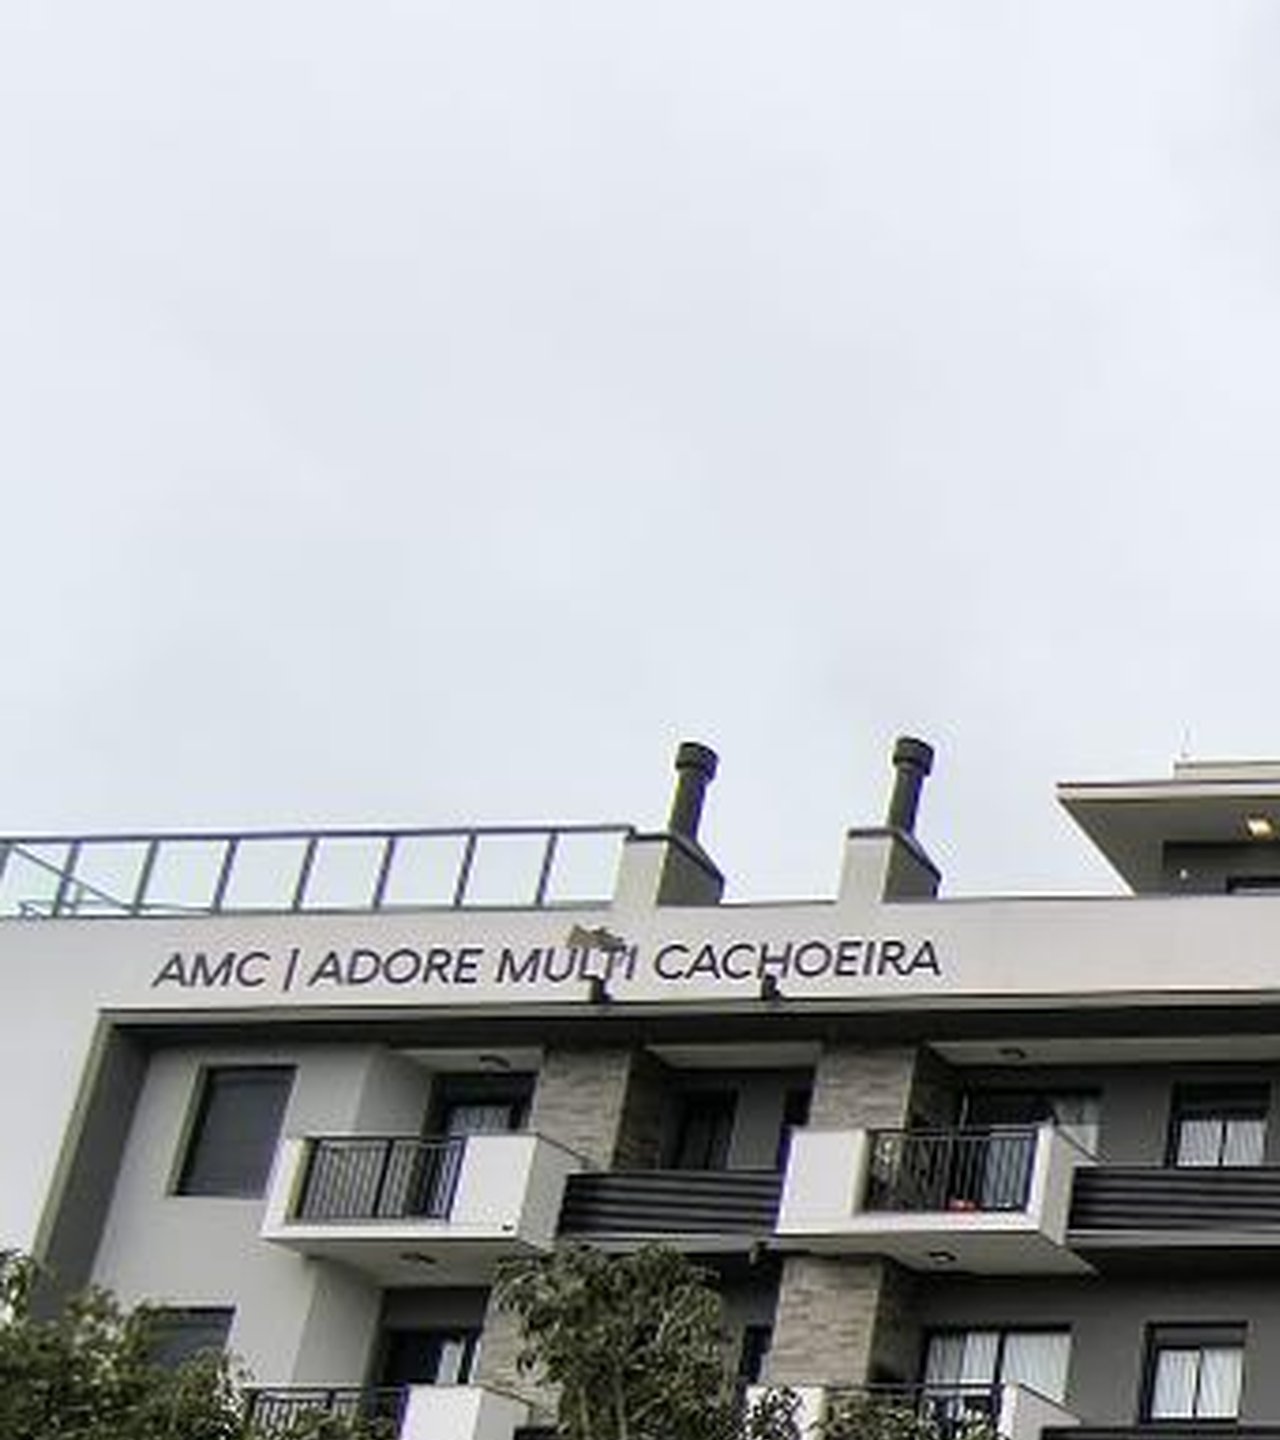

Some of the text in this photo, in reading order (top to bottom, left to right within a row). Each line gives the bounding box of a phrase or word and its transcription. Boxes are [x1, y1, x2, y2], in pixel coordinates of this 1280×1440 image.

[153, 950, 271, 988] AMC
[310, 947, 482, 985] ADORE
[496, 944, 639, 983] MULTI
[653, 940, 942, 980] CACHOEIRA
